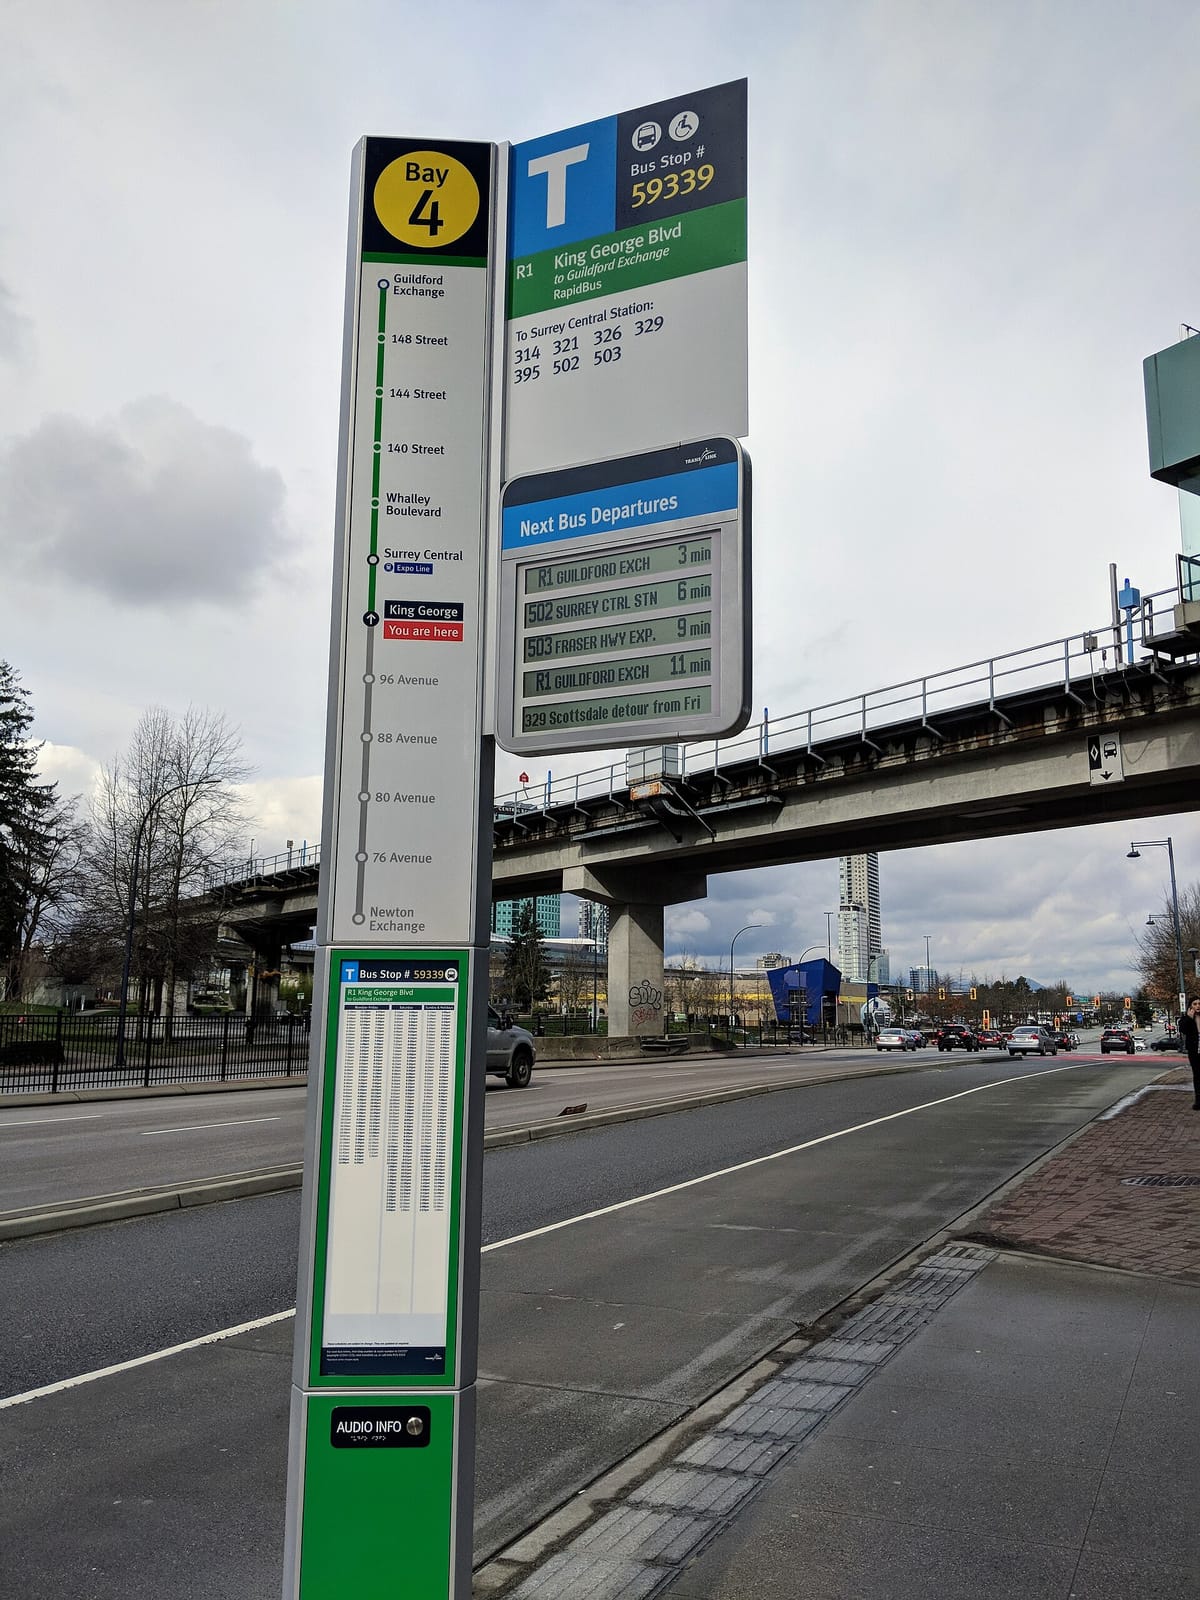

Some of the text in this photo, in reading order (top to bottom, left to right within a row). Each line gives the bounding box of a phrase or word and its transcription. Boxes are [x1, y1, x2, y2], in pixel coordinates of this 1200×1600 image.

[631, 145, 705, 176] Bus Stop #
[405, 162, 449, 188] Bay
[528, 143, 590, 229] T
[631, 164, 715, 208] 59339
[408, 190, 444, 236] 4
[516, 223, 682, 279] R1 King George Blvd
[554, 246, 670, 285] to Guildford Exchange
[393, 274, 443, 285] Guildford
[393, 286, 445, 298] Exchange
[554, 279, 602, 300] RapidBus
[516, 301, 654, 342] To Surrey Central Station:
[391, 334, 448, 346] 148 Street
[514, 316, 664, 365] 314 321 326 329
[514, 347, 622, 384] 395 502 503
[390, 389, 447, 400] 144 Street
[388, 443, 445, 455] 140 Street
[386, 493, 431, 506] Whalley
[386, 506, 442, 517] Boulevard
[520, 495, 678, 538] Next Bus Departures
[384, 548, 463, 561] Surrey Central
[396, 565, 430, 573] Expo Line
[538, 545, 711, 588] R1 GUILDFORD EXCH 3 min
[528, 581, 711, 623] 502 SURREY CTRL STN 6 min
[389, 605, 458, 620] King George
[389, 625, 459, 637] You are here
[528, 617, 711, 656] 503 FRASER HWY EXP. 9 min
[379, 674, 439, 686] 96 Avenue
[536, 655, 711, 691] R1 GUILDFORD EXCH 11 min
[525, 695, 701, 728] 329 Scottsdale detour from Fri
[377, 733, 438, 744] 88 Avenue
[375, 792, 435, 803] 80 Avenue
[372, 853, 432, 864] 76 Avenue
[370, 907, 414, 918] Newton
[369, 920, 425, 934] Exchange
[345, 968, 444, 981] T Bus Stop # 59339
[358, 988, 372, 997] King
[373, 988, 398, 997] George
[399, 988, 414, 996] Blvd
[336, 1420, 402, 1433] AUDIO INFO
